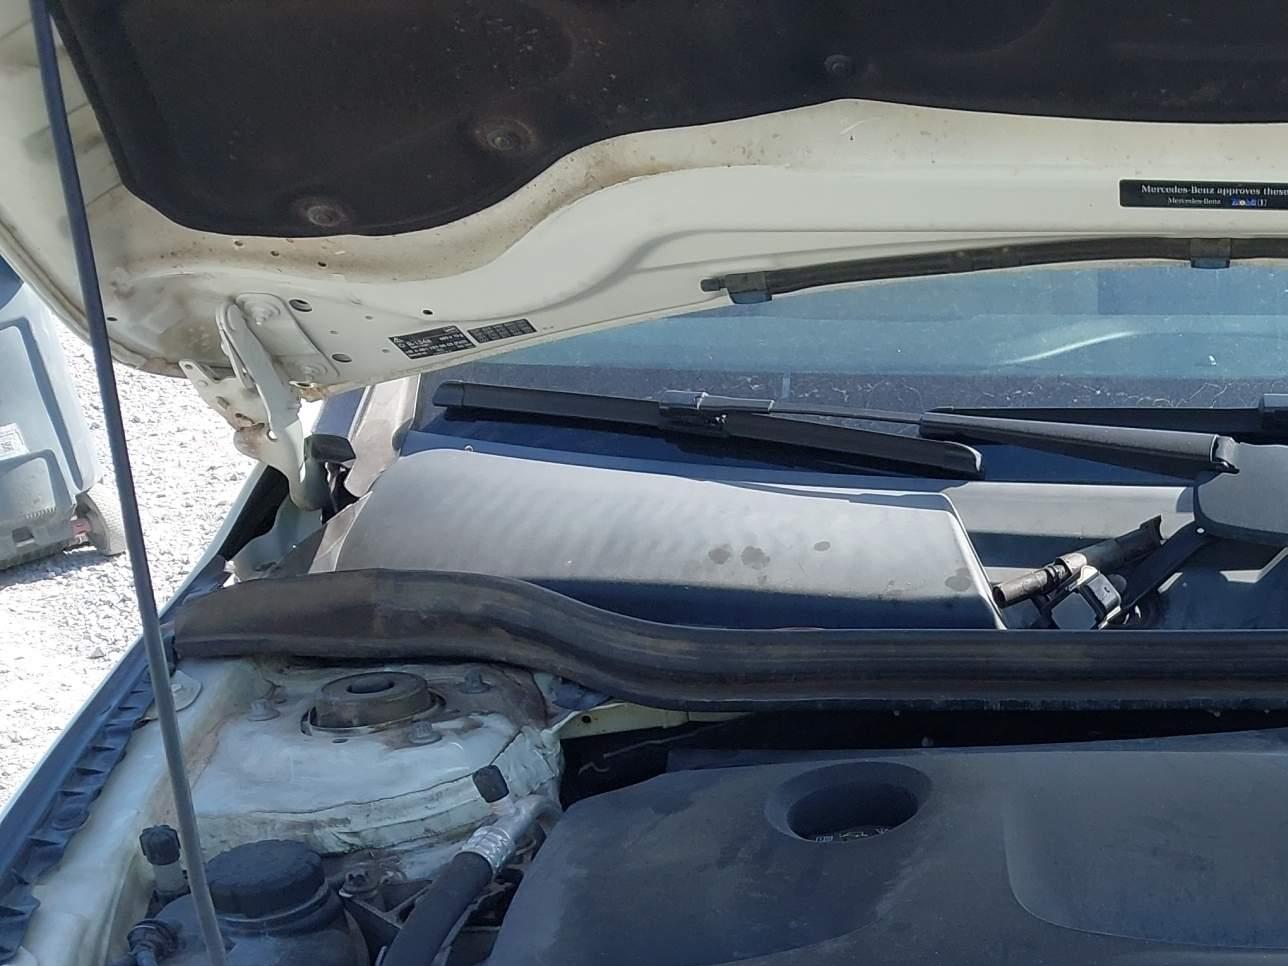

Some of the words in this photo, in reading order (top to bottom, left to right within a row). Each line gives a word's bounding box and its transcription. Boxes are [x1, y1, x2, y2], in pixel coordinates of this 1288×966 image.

[1141, 184, 1215, 195] Mercedes-Benz
[1217, 188, 1261, 198] approves
[1167, 196, 1221, 205] Mercedes-Benz
